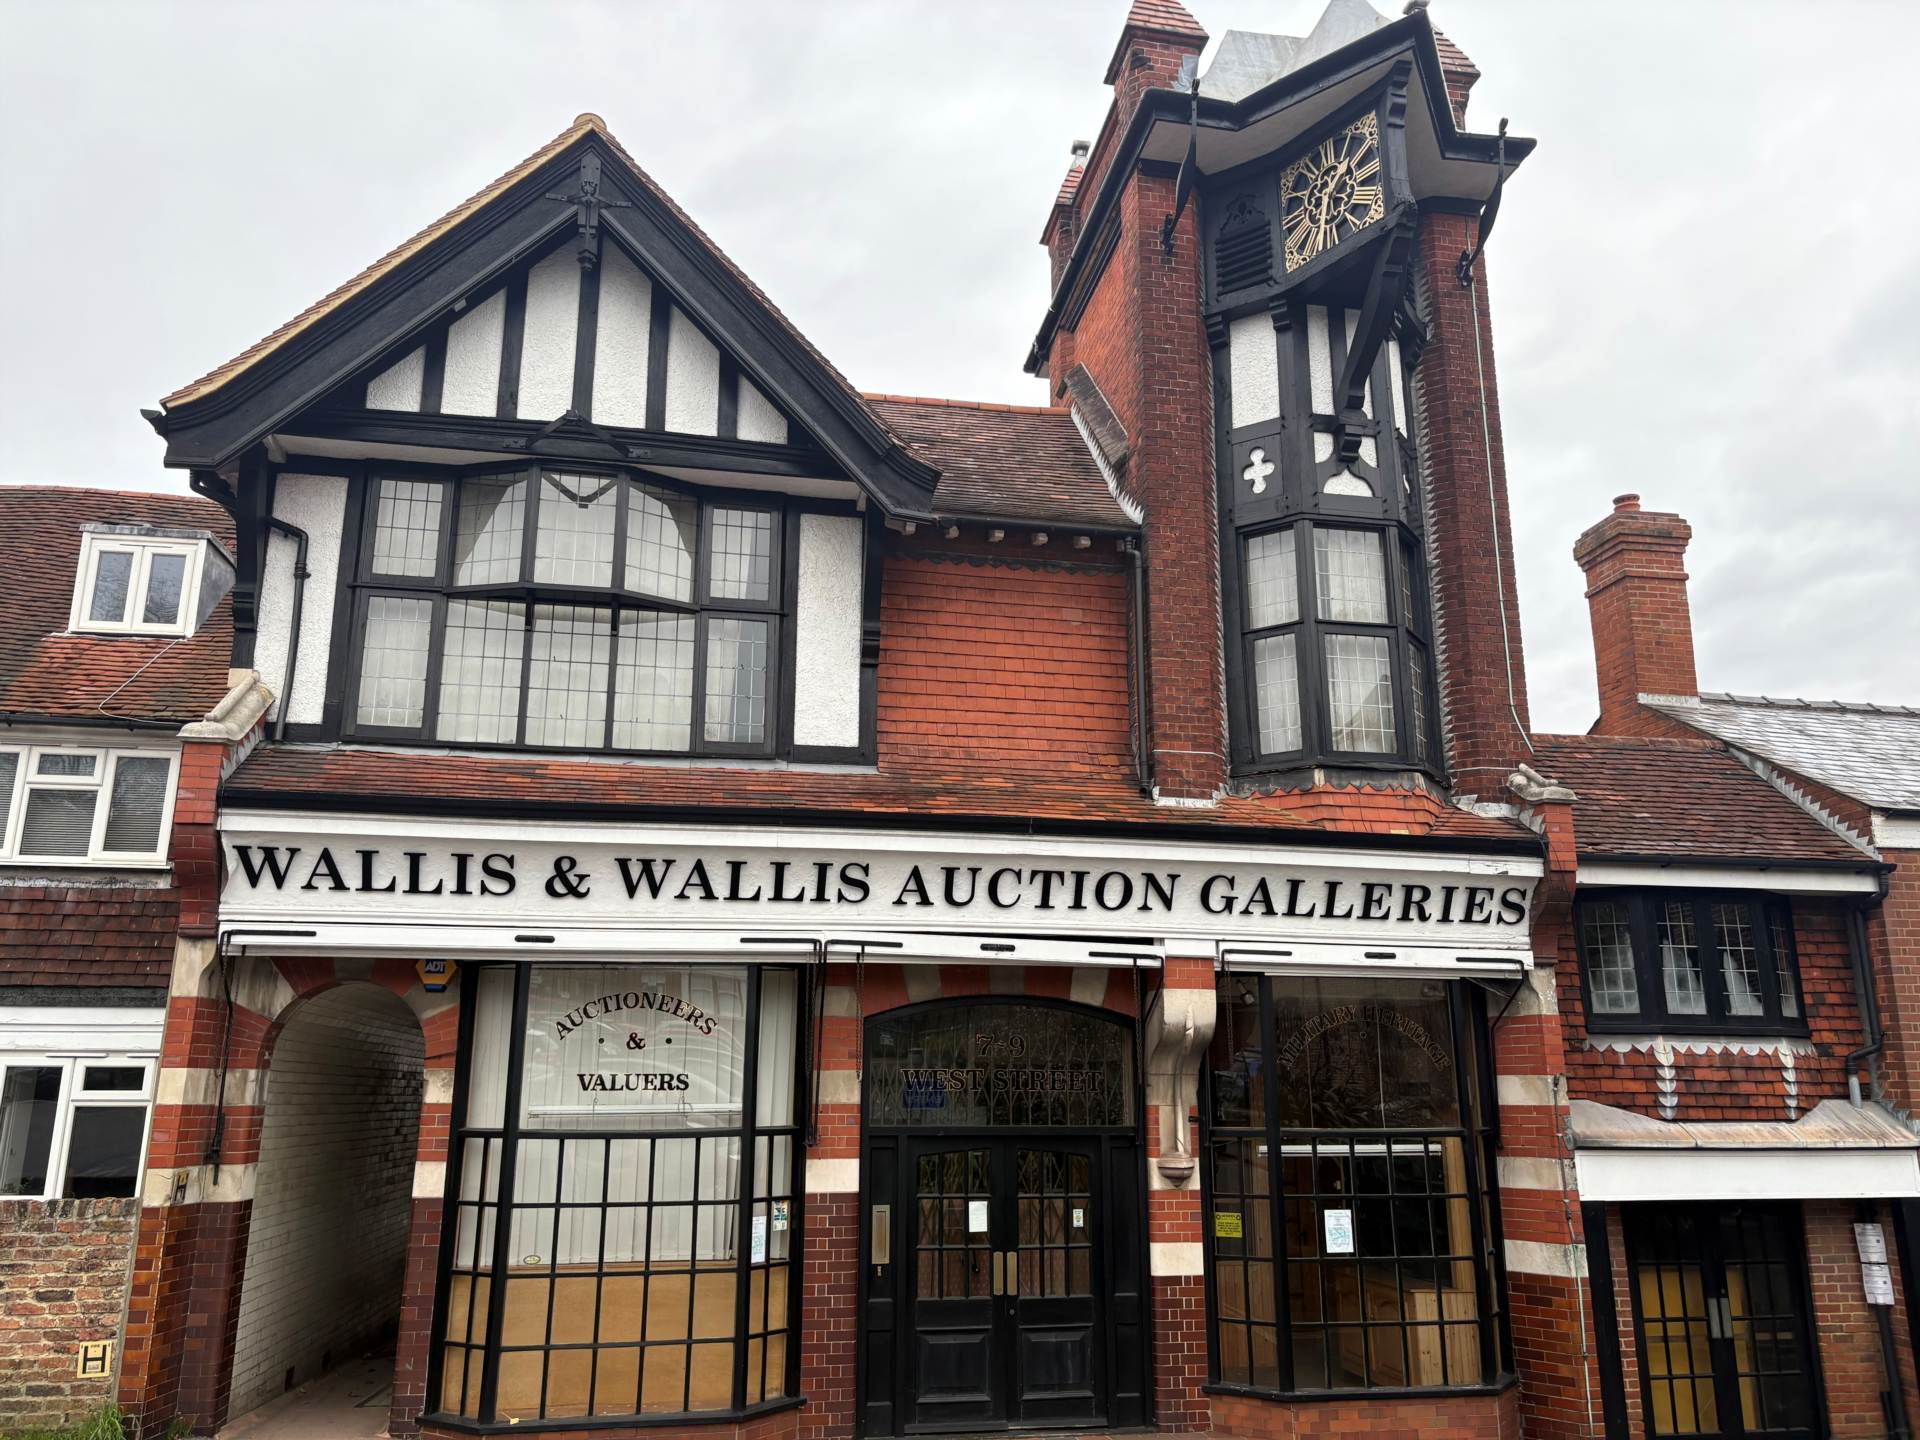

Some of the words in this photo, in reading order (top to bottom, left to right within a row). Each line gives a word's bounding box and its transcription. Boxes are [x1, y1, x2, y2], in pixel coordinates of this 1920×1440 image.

[232, 845, 516, 897] WALLIS
[545, 856, 591, 899] &
[614, 858, 870, 904] WALLIS
[893, 865, 1182, 912] AUCTION
[1200, 875, 1529, 926] GALLERIES
[425, 961, 446, 972] ADT
[553, 991, 719, 1041] AUCTIONEERS
[626, 1032, 646, 1050] &
[975, 1032, 1026, 1057] 7-9
[1277, 1004, 1358, 1070] MILITARY
[577, 1073, 691, 1091] VALUERS
[901, 1068, 985, 1092] WEST
[992, 1069, 1105, 1093] STREET
[82, 1344, 107, 1375] H
